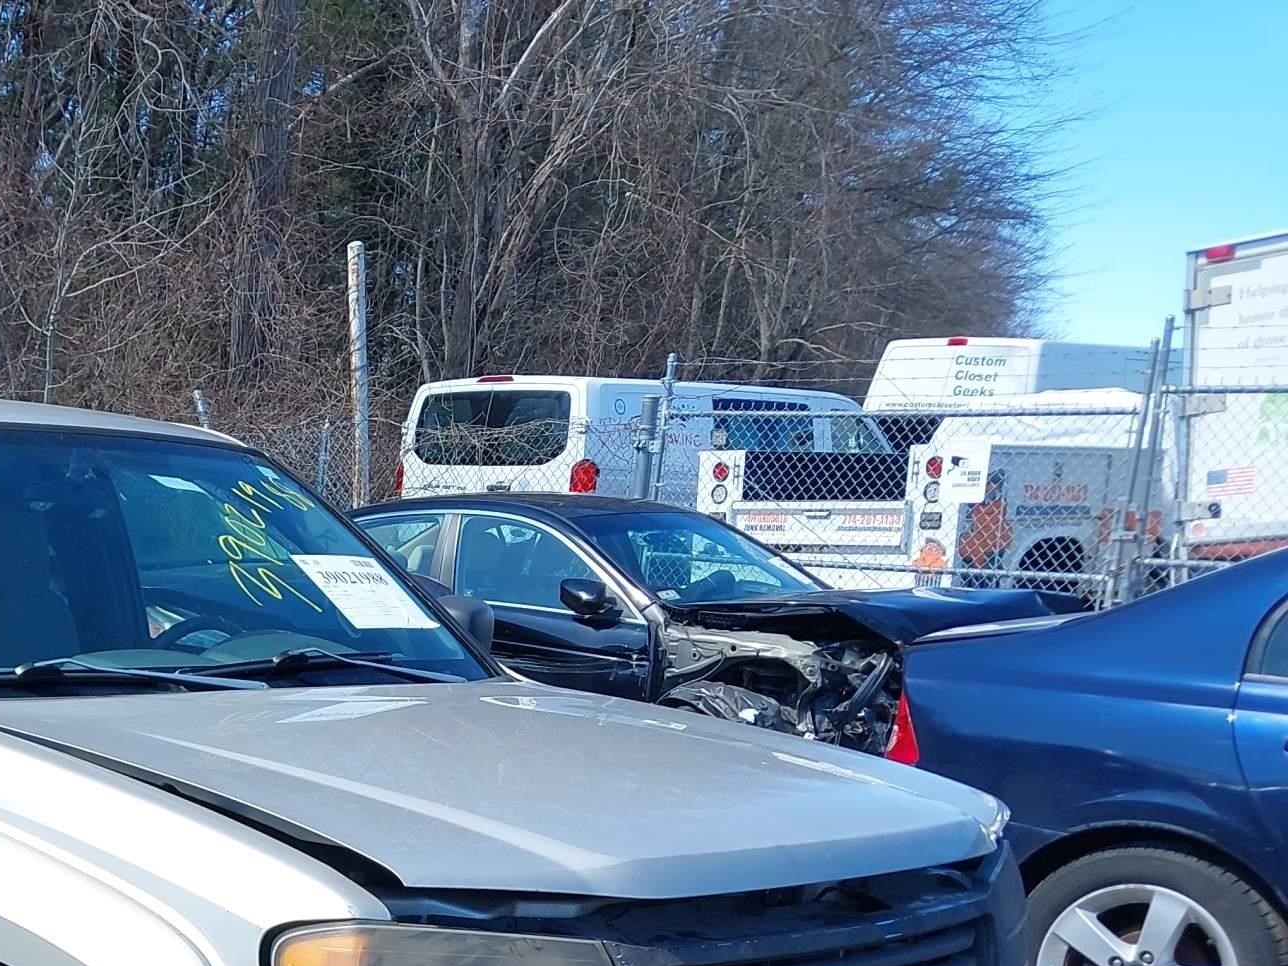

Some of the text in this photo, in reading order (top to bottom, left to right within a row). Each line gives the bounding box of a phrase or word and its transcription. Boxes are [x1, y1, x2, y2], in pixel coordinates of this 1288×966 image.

[955, 354, 1007, 367] Custom
[954, 370, 998, 382] Closet
[952, 385, 995, 397] Geeks
[316, 570, 390, 587] 39021988
